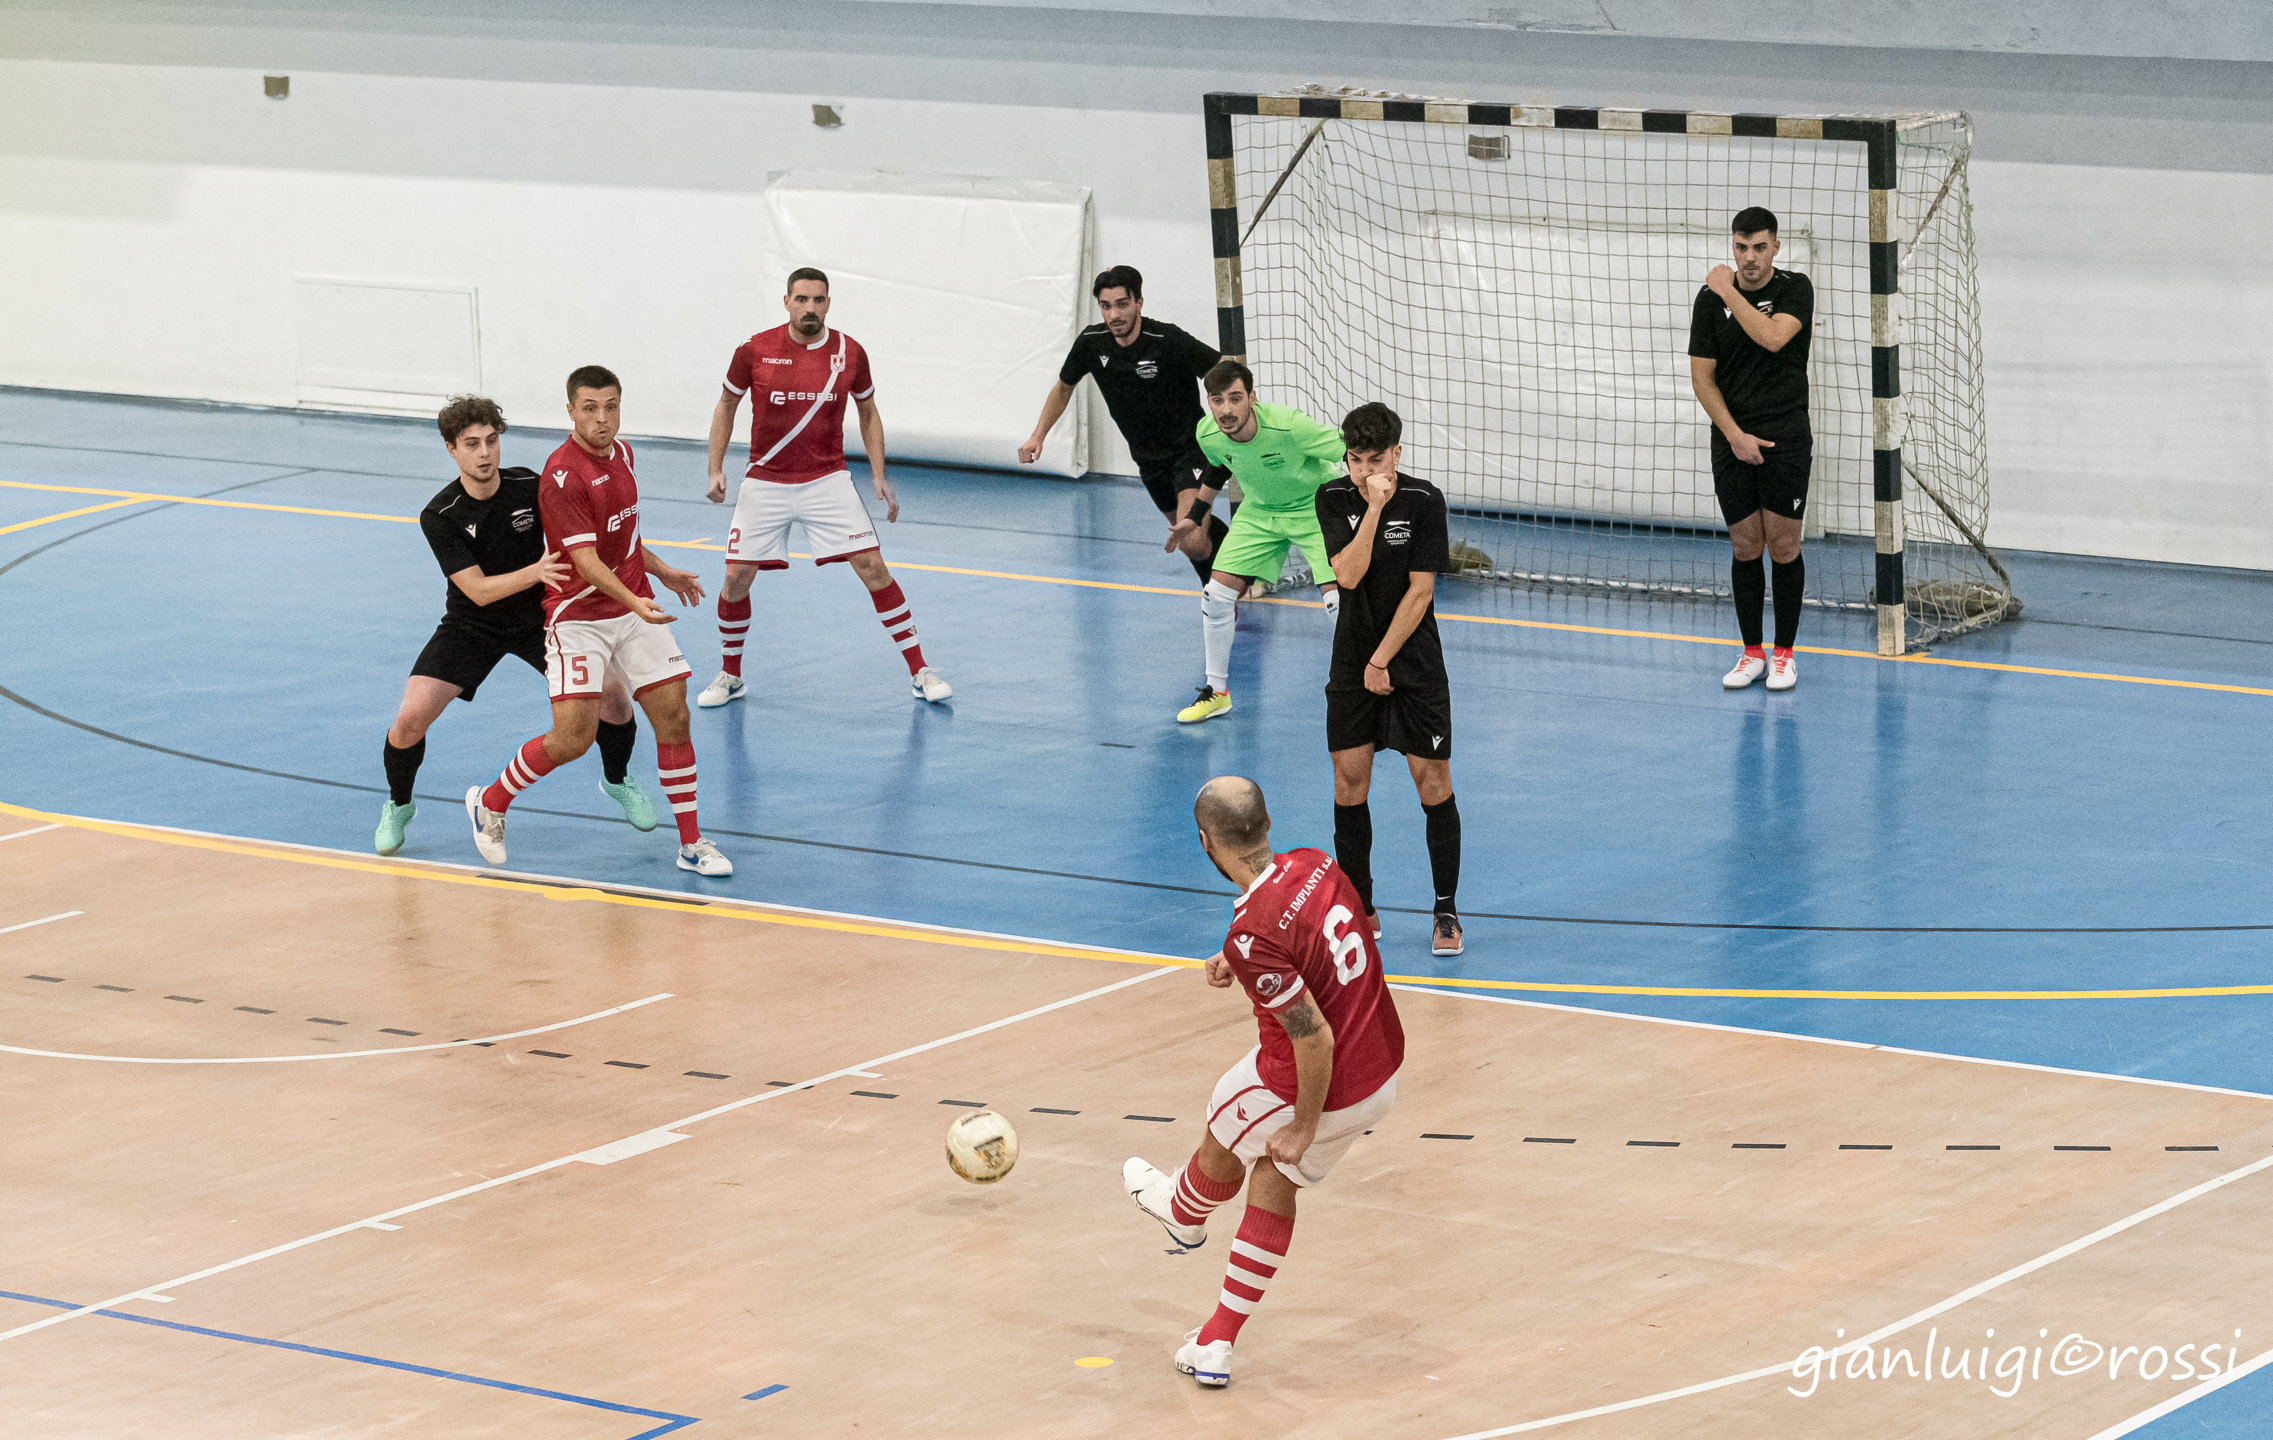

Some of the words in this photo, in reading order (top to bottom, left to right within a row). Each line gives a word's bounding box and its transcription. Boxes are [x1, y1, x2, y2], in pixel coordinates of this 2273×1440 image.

[762, 357, 793, 365] macron
[728, 528, 742, 555] 2
[571, 655, 589, 686] 5
[1289, 867, 1326, 914] IMPIANTI
[1322, 903, 1368, 987] 6
